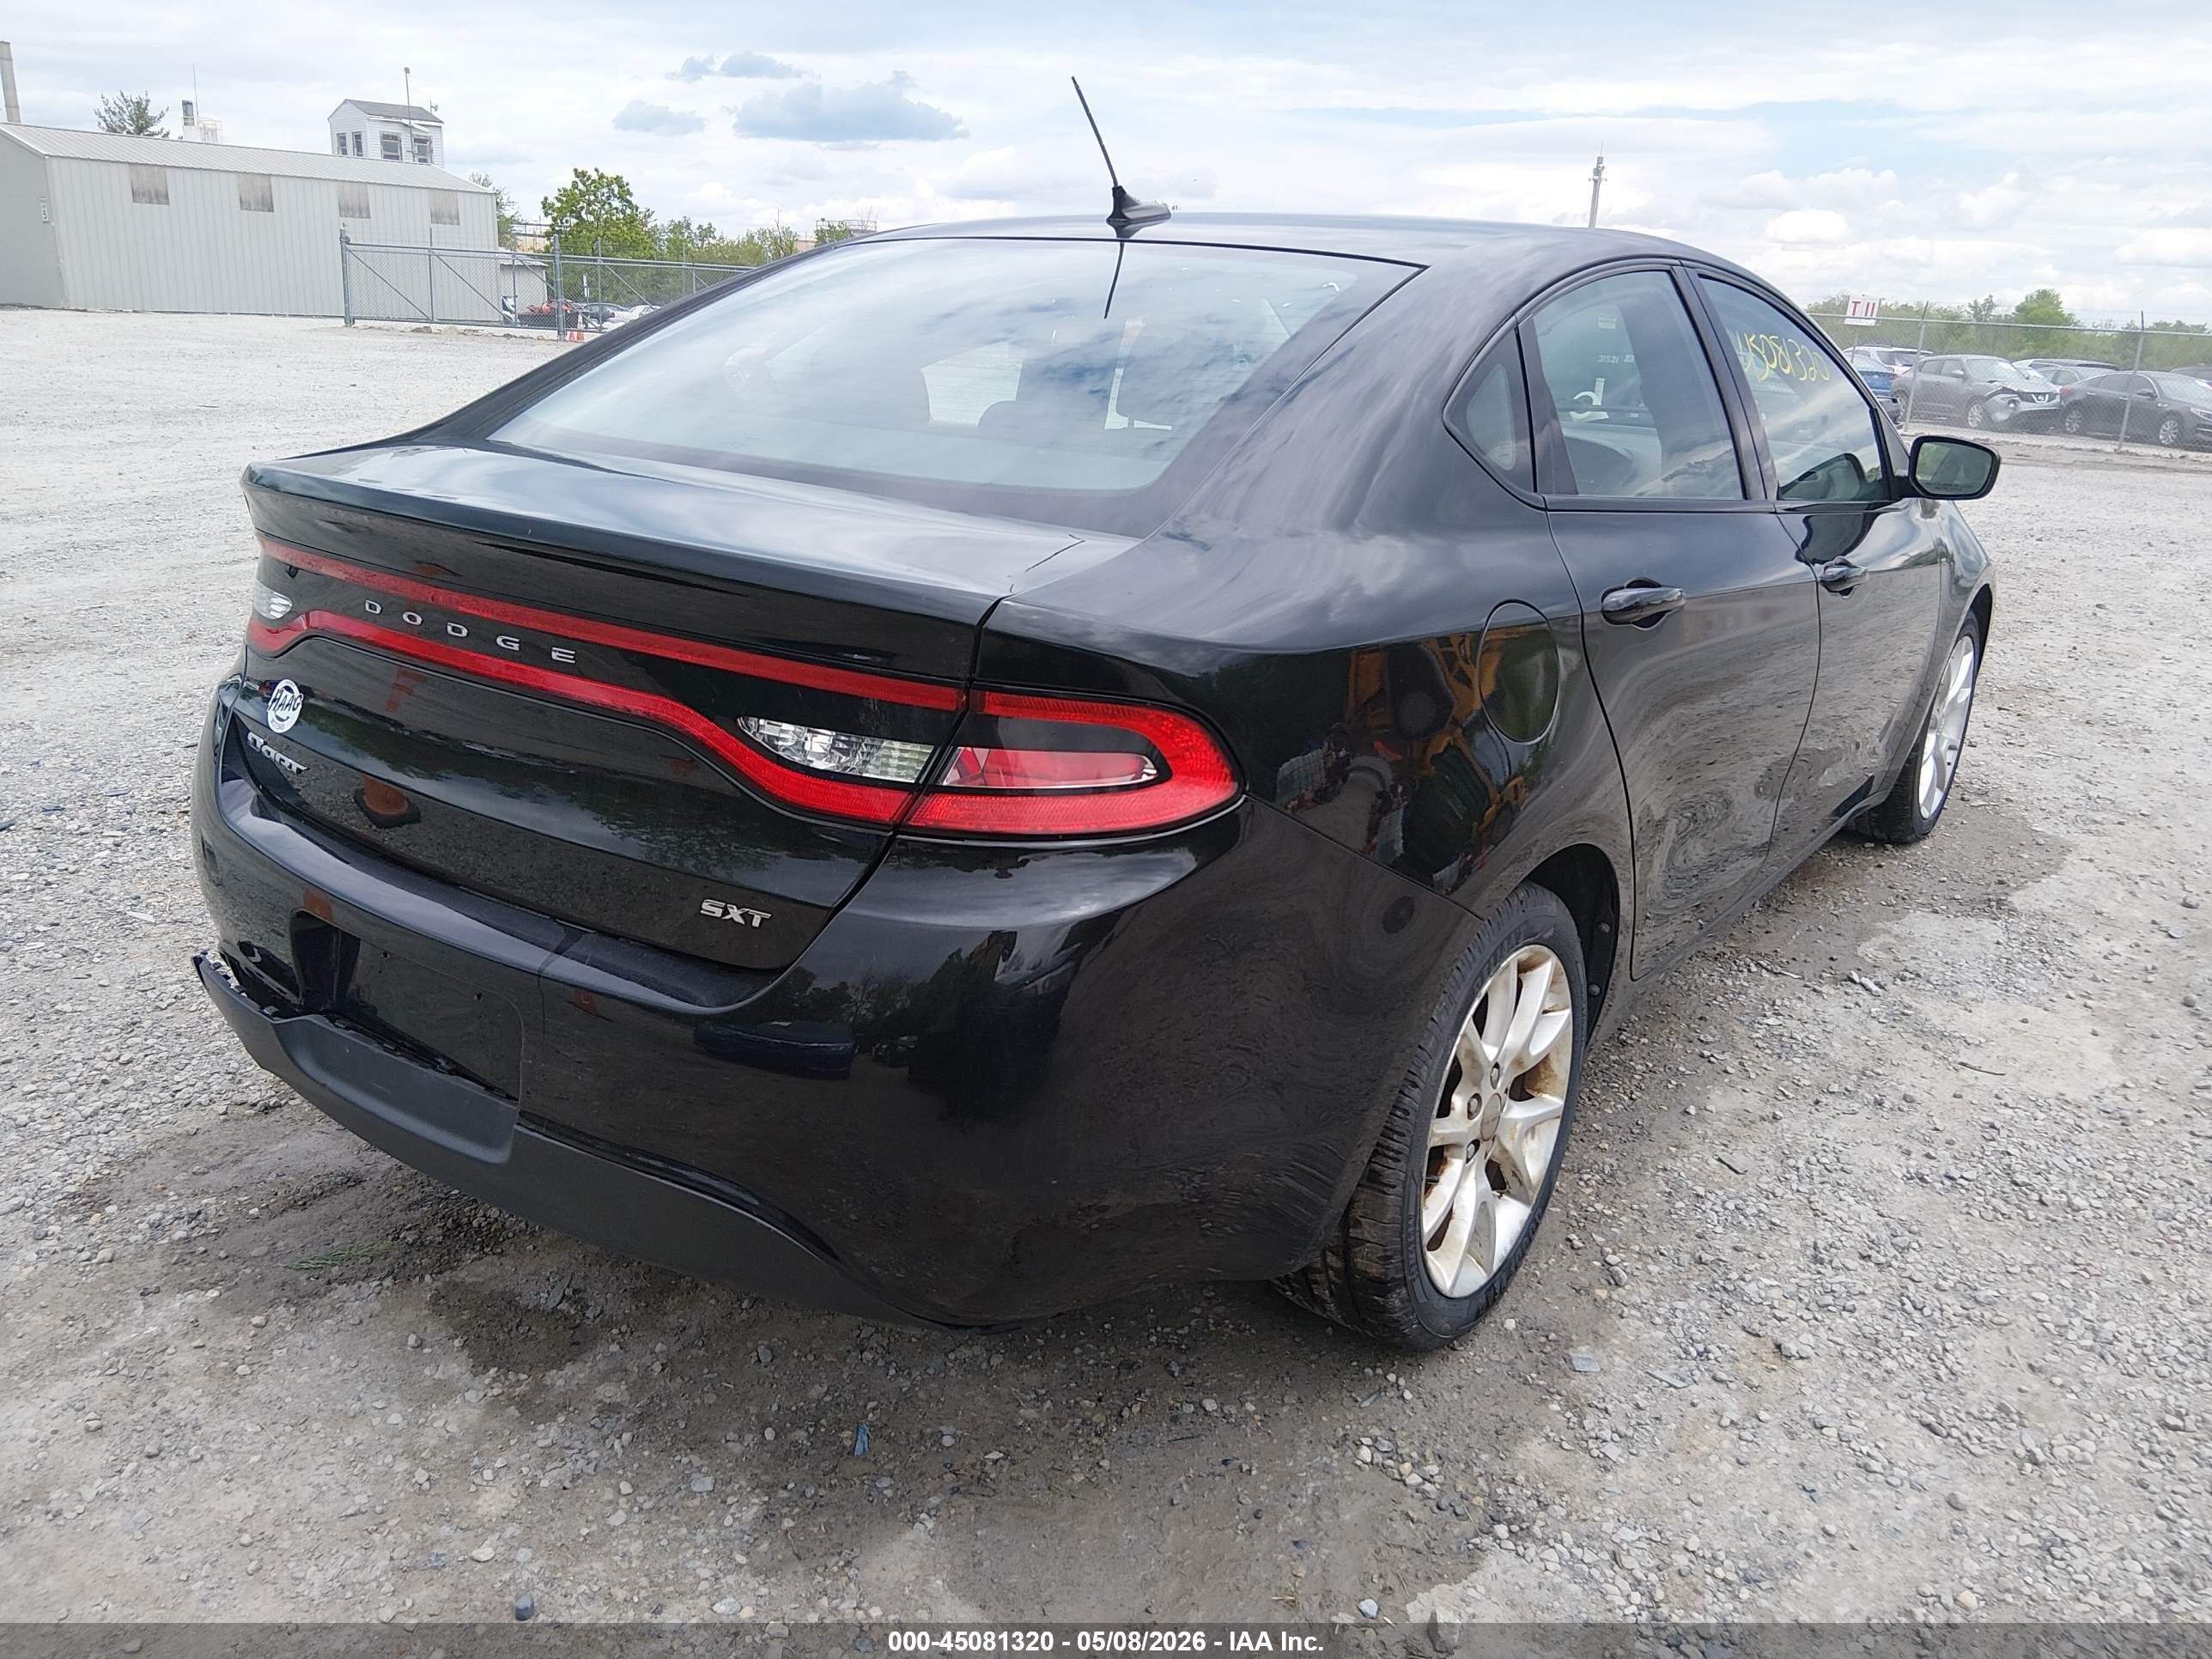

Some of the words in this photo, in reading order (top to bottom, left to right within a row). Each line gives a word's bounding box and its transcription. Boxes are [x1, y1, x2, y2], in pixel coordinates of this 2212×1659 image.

[365, 599, 576, 664] DODGE
[267, 688, 303, 712] HAAG
[700, 899, 772, 928] SXT
